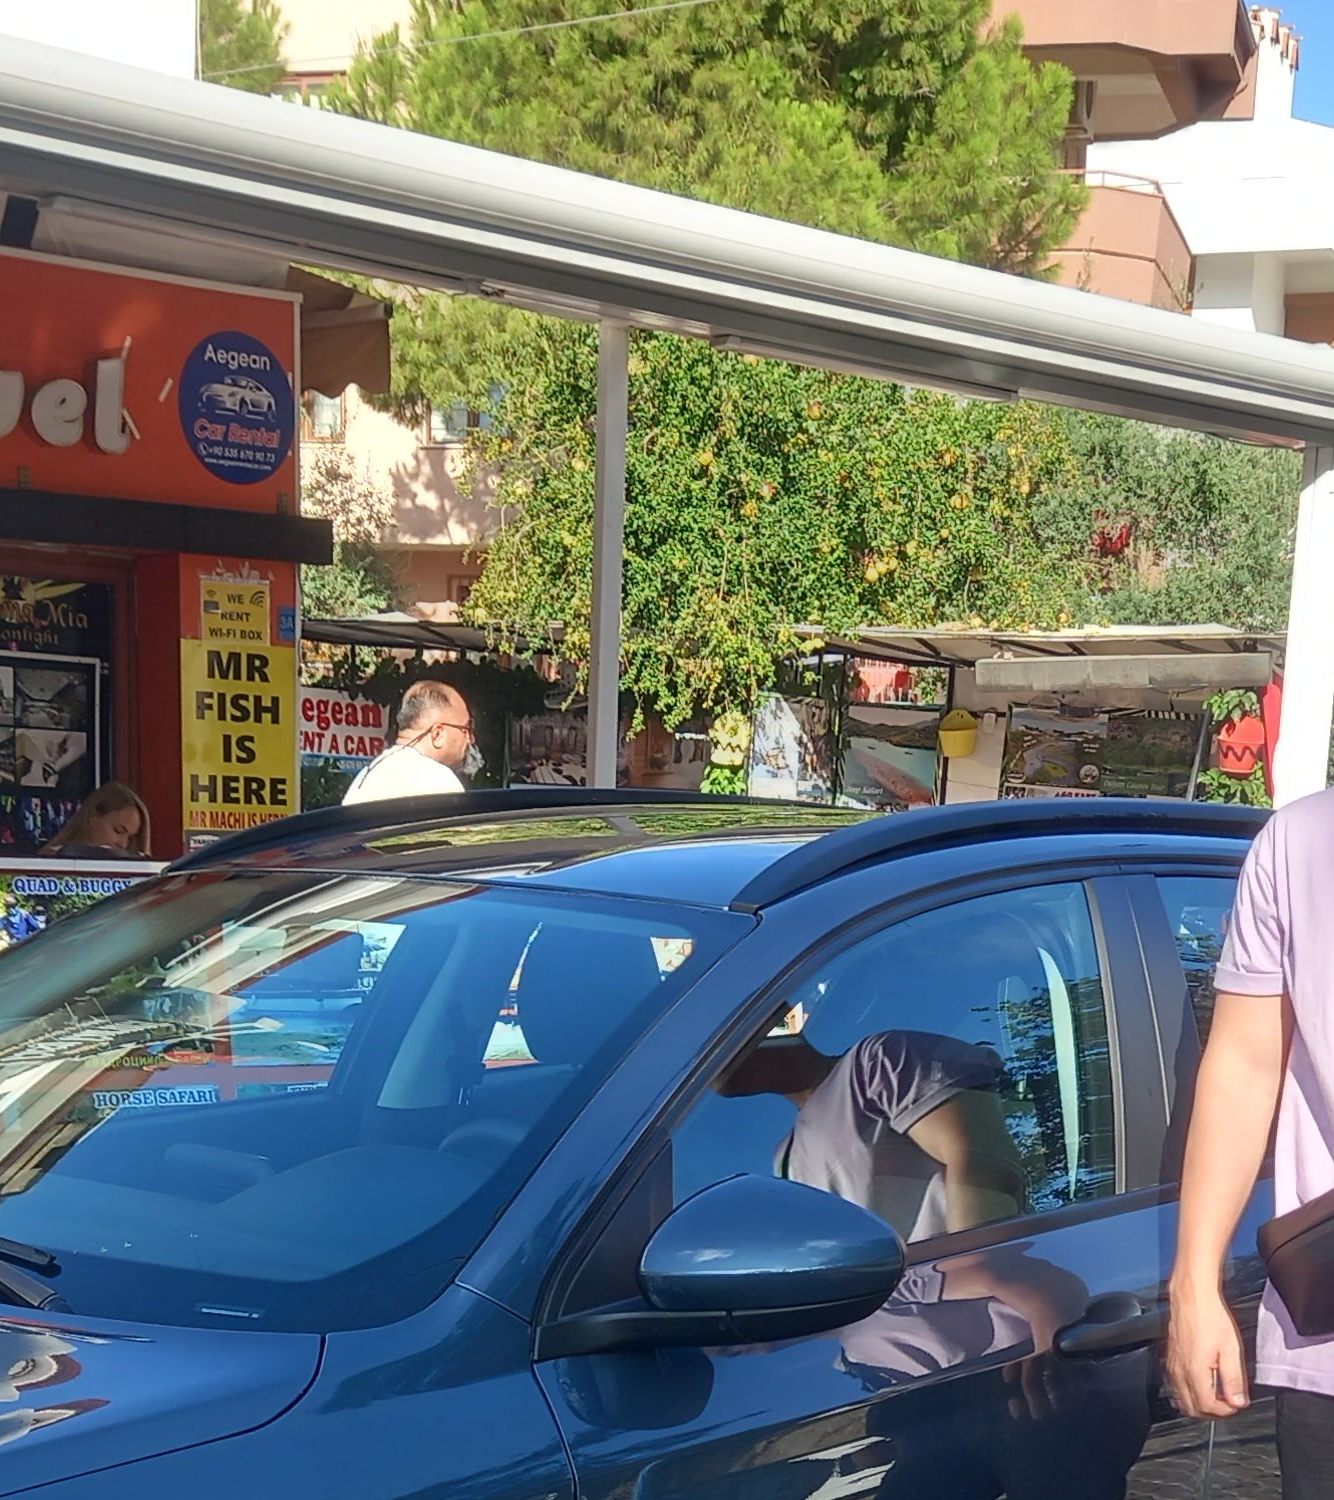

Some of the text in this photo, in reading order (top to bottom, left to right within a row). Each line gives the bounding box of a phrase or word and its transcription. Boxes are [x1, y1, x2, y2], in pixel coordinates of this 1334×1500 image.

[204, 344, 270, 370] Aegean
[194, 418, 281, 448] Car Rental
[227, 593, 245, 605] WE
[42, 600, 89, 629] Mia
[220, 611, 251, 622] RENT
[208, 627, 263, 641] WI-FI BOX
[206, 650, 271, 683] MR
[195, 690, 281, 725] FISH
[222, 733, 257, 764] IS
[300, 730, 384, 756] NT A CAR
[190, 774, 288, 806] HERE
[189, 811, 207, 828] MR
[209, 811, 245, 829] MACHI
[14, 877, 132, 895] QUAD & BUGGY
[95, 1089, 214, 1107] HORSE SAFARI
